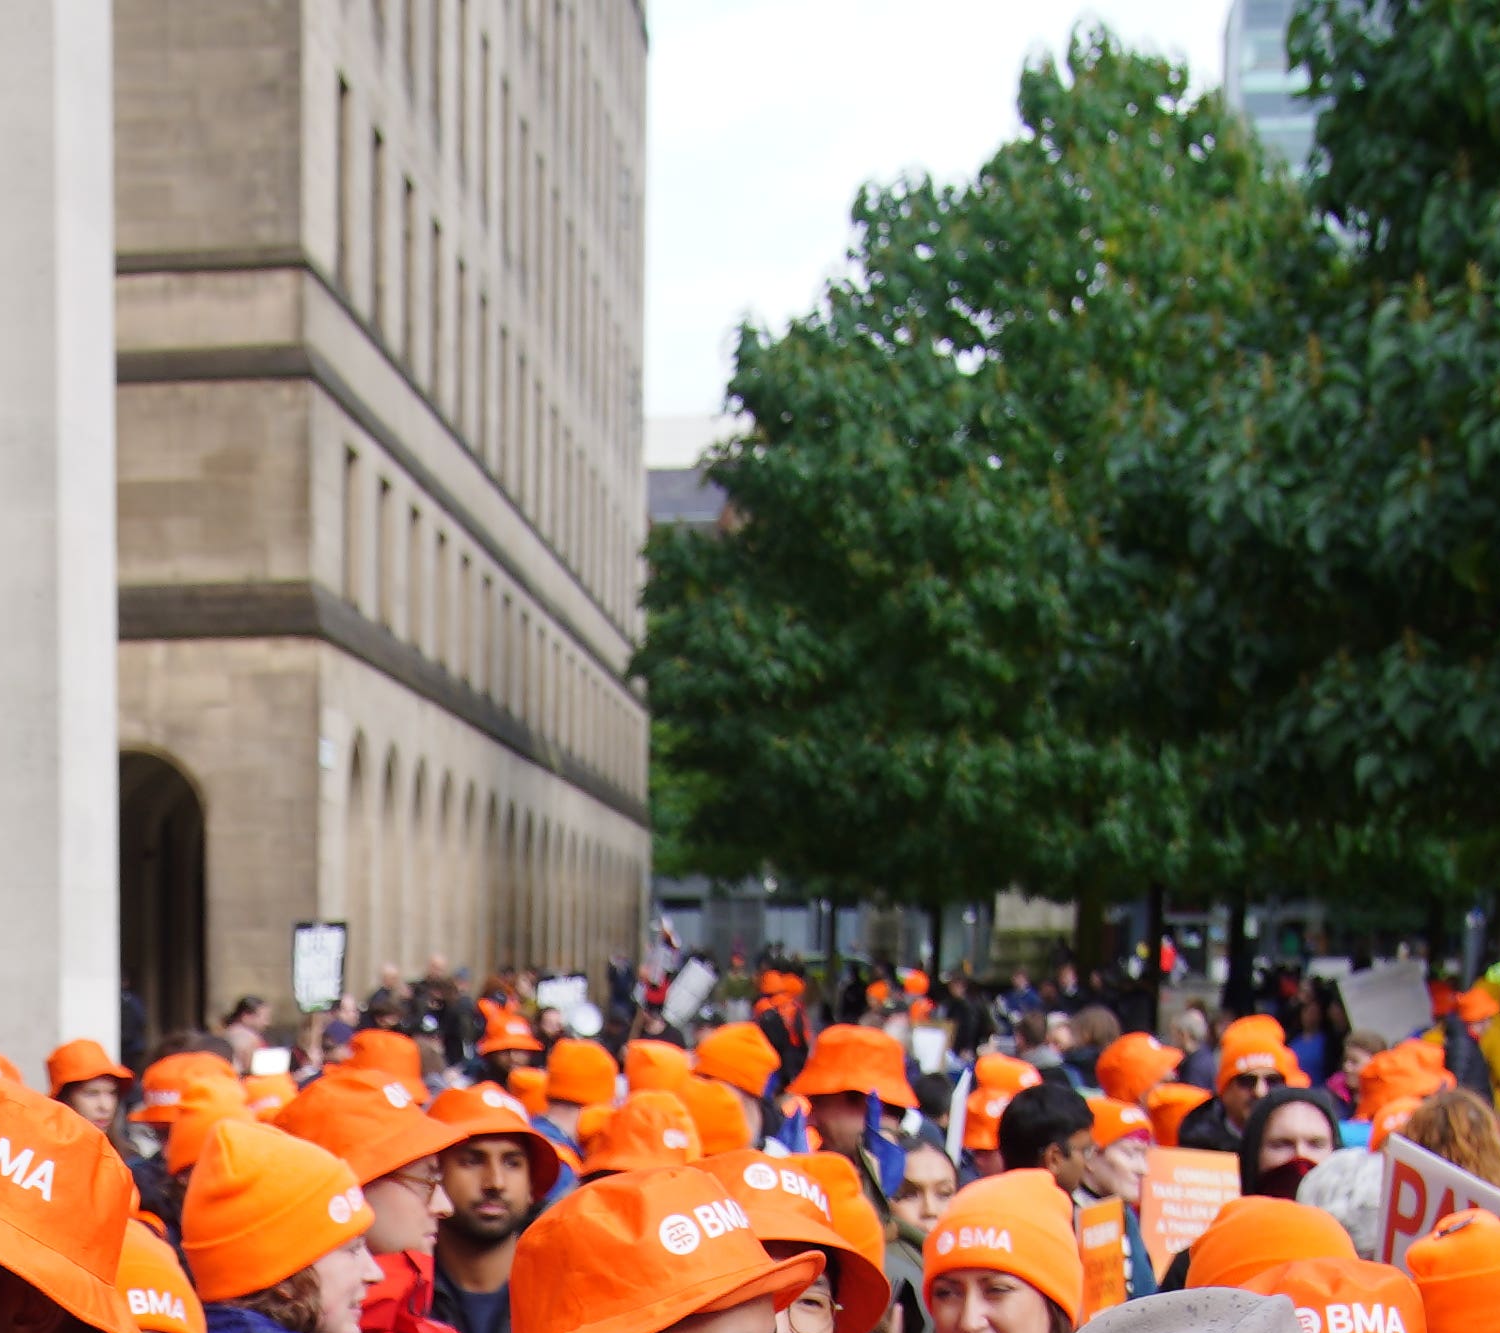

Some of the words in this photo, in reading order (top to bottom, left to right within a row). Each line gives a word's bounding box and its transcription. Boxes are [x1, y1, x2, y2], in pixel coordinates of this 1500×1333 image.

[780, 1171, 832, 1225] BMA
[957, 1227, 1013, 1256] BMA
[127, 1287, 187, 1325] BMA
